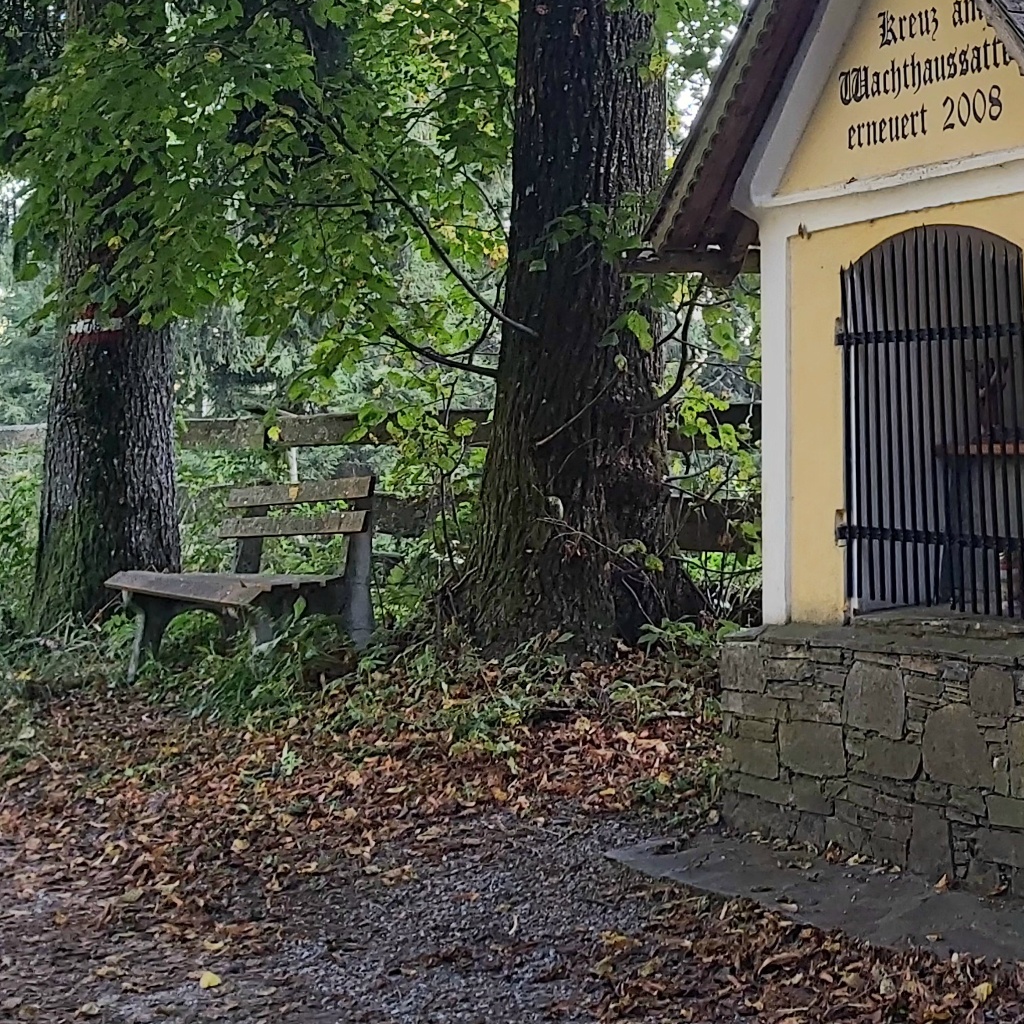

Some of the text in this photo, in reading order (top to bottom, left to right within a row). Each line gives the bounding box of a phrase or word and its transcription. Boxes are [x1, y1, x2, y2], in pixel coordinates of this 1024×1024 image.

[878, 6, 939, 49] Kreuz
[847, 84, 1003, 150] erneuert 2008
